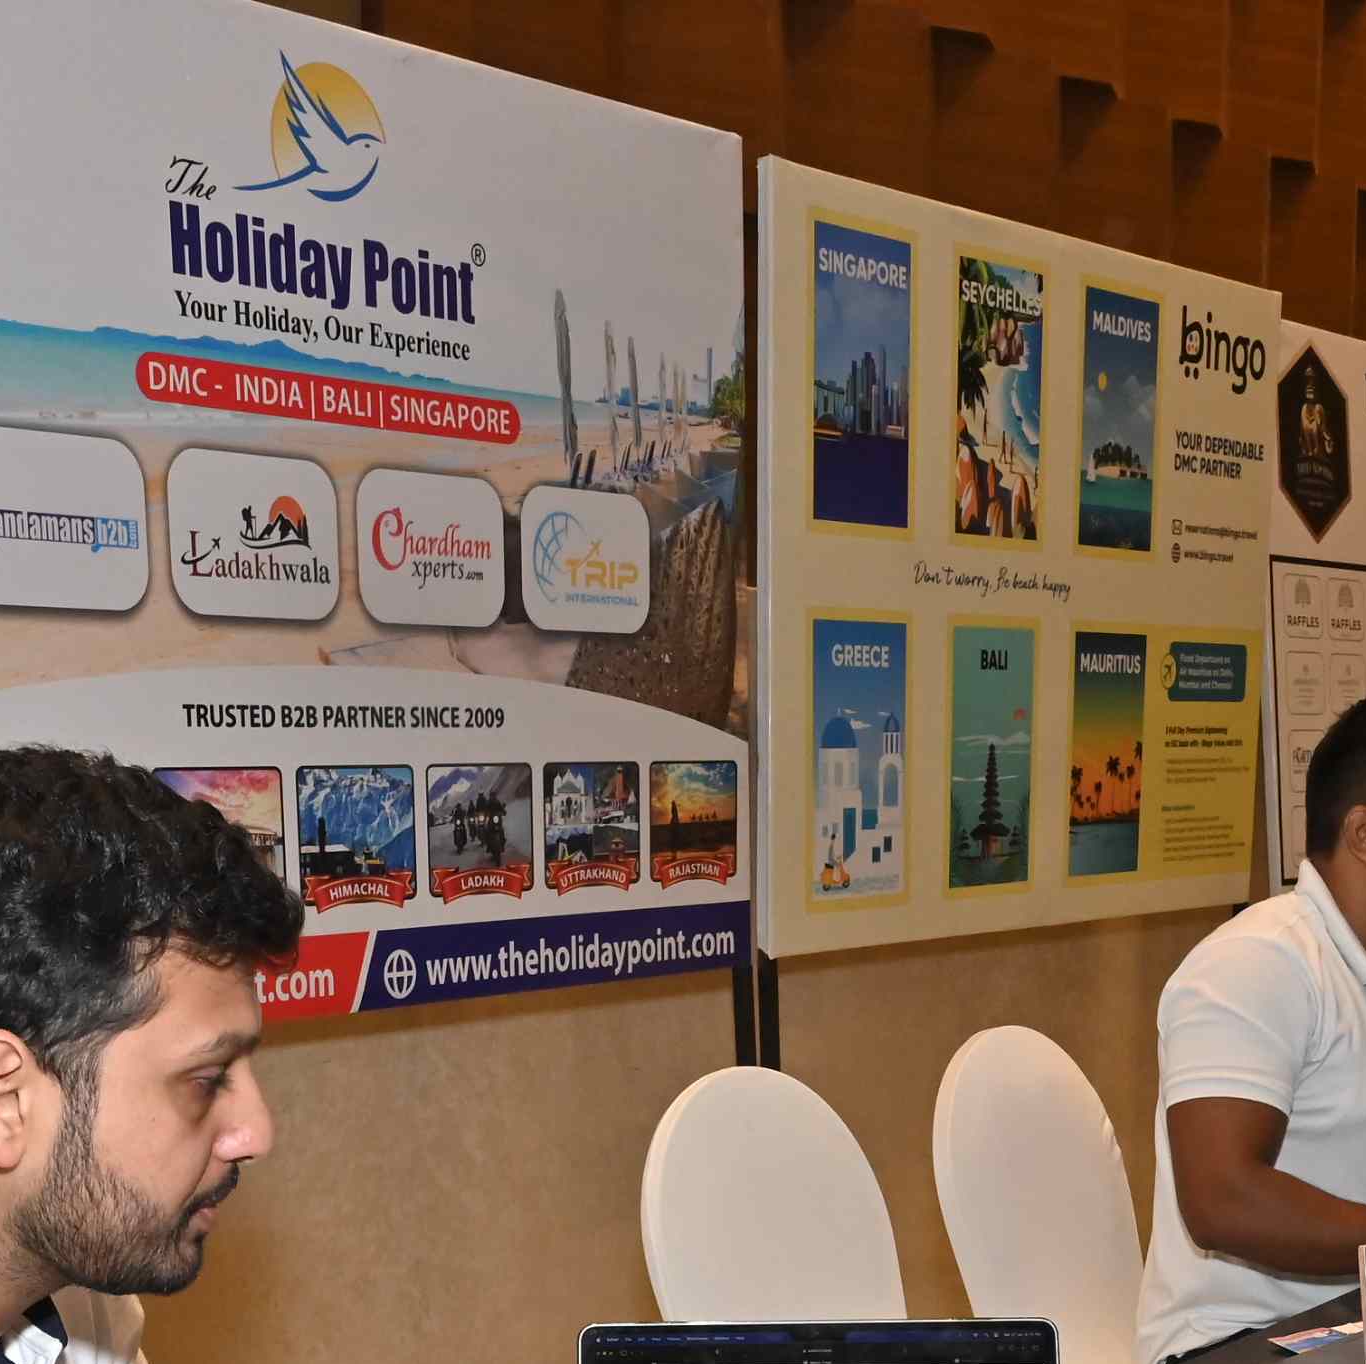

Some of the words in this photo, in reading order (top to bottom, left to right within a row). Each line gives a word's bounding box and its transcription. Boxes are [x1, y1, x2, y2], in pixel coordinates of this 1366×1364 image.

[164, 155, 217, 201] The
[168, 200, 353, 311] Holiday
[363, 238, 477, 326] Point
[818, 246, 908, 289] SINGAPORE
[960, 279, 1042, 318] SEYCHELLES
[173, 289, 228, 324] Your
[233, 300, 319, 343] Holiday,
[324, 315, 364, 345] Our
[369, 322, 472, 362] Experience
[1091, 309, 1152, 344] MALDIVES
[1178, 305, 1267, 394] bingo
[147, 360, 208, 397] DMC
[234, 373, 304, 411] INDIA
[322, 384, 374, 418] BALI
[390, 394, 512, 436] SINGAPORE
[1175, 430, 1204, 452] YOUR
[1204, 434, 1265, 463] DEPENDABLE
[1174, 453, 1198, 475] DMC
[1199, 457, 1242, 480] PARTNER
[371, 507, 492, 572] Chardham
[181, 530, 332, 585] Ladakhwala
[563, 557, 643, 591] TRIP
[1041, 574, 1072, 603] happy
[1286, 615, 1320, 628] RAFFLES
[1330, 618, 1362, 631] RAFFLES
[831, 643, 891, 669] GREECE
[979, 648, 1009, 671] BALI
[1079, 652, 1142, 675] MAURITIUS
[182, 702, 277, 731] TRUSTED
[281, 704, 319, 731] B2B
[322, 705, 407, 731] PARTNER
[410, 705, 462, 730] SINCE
[464, 705, 505, 730] 2009
[461, 875, 505, 890] LADAKH
[561, 868, 628, 888] UTTRAKHAND
[668, 863, 721, 879] RAJASTHAN
[329, 880, 391, 900] HIMACHAL
[425, 926, 736, 988] www.theholidaypoint.com
